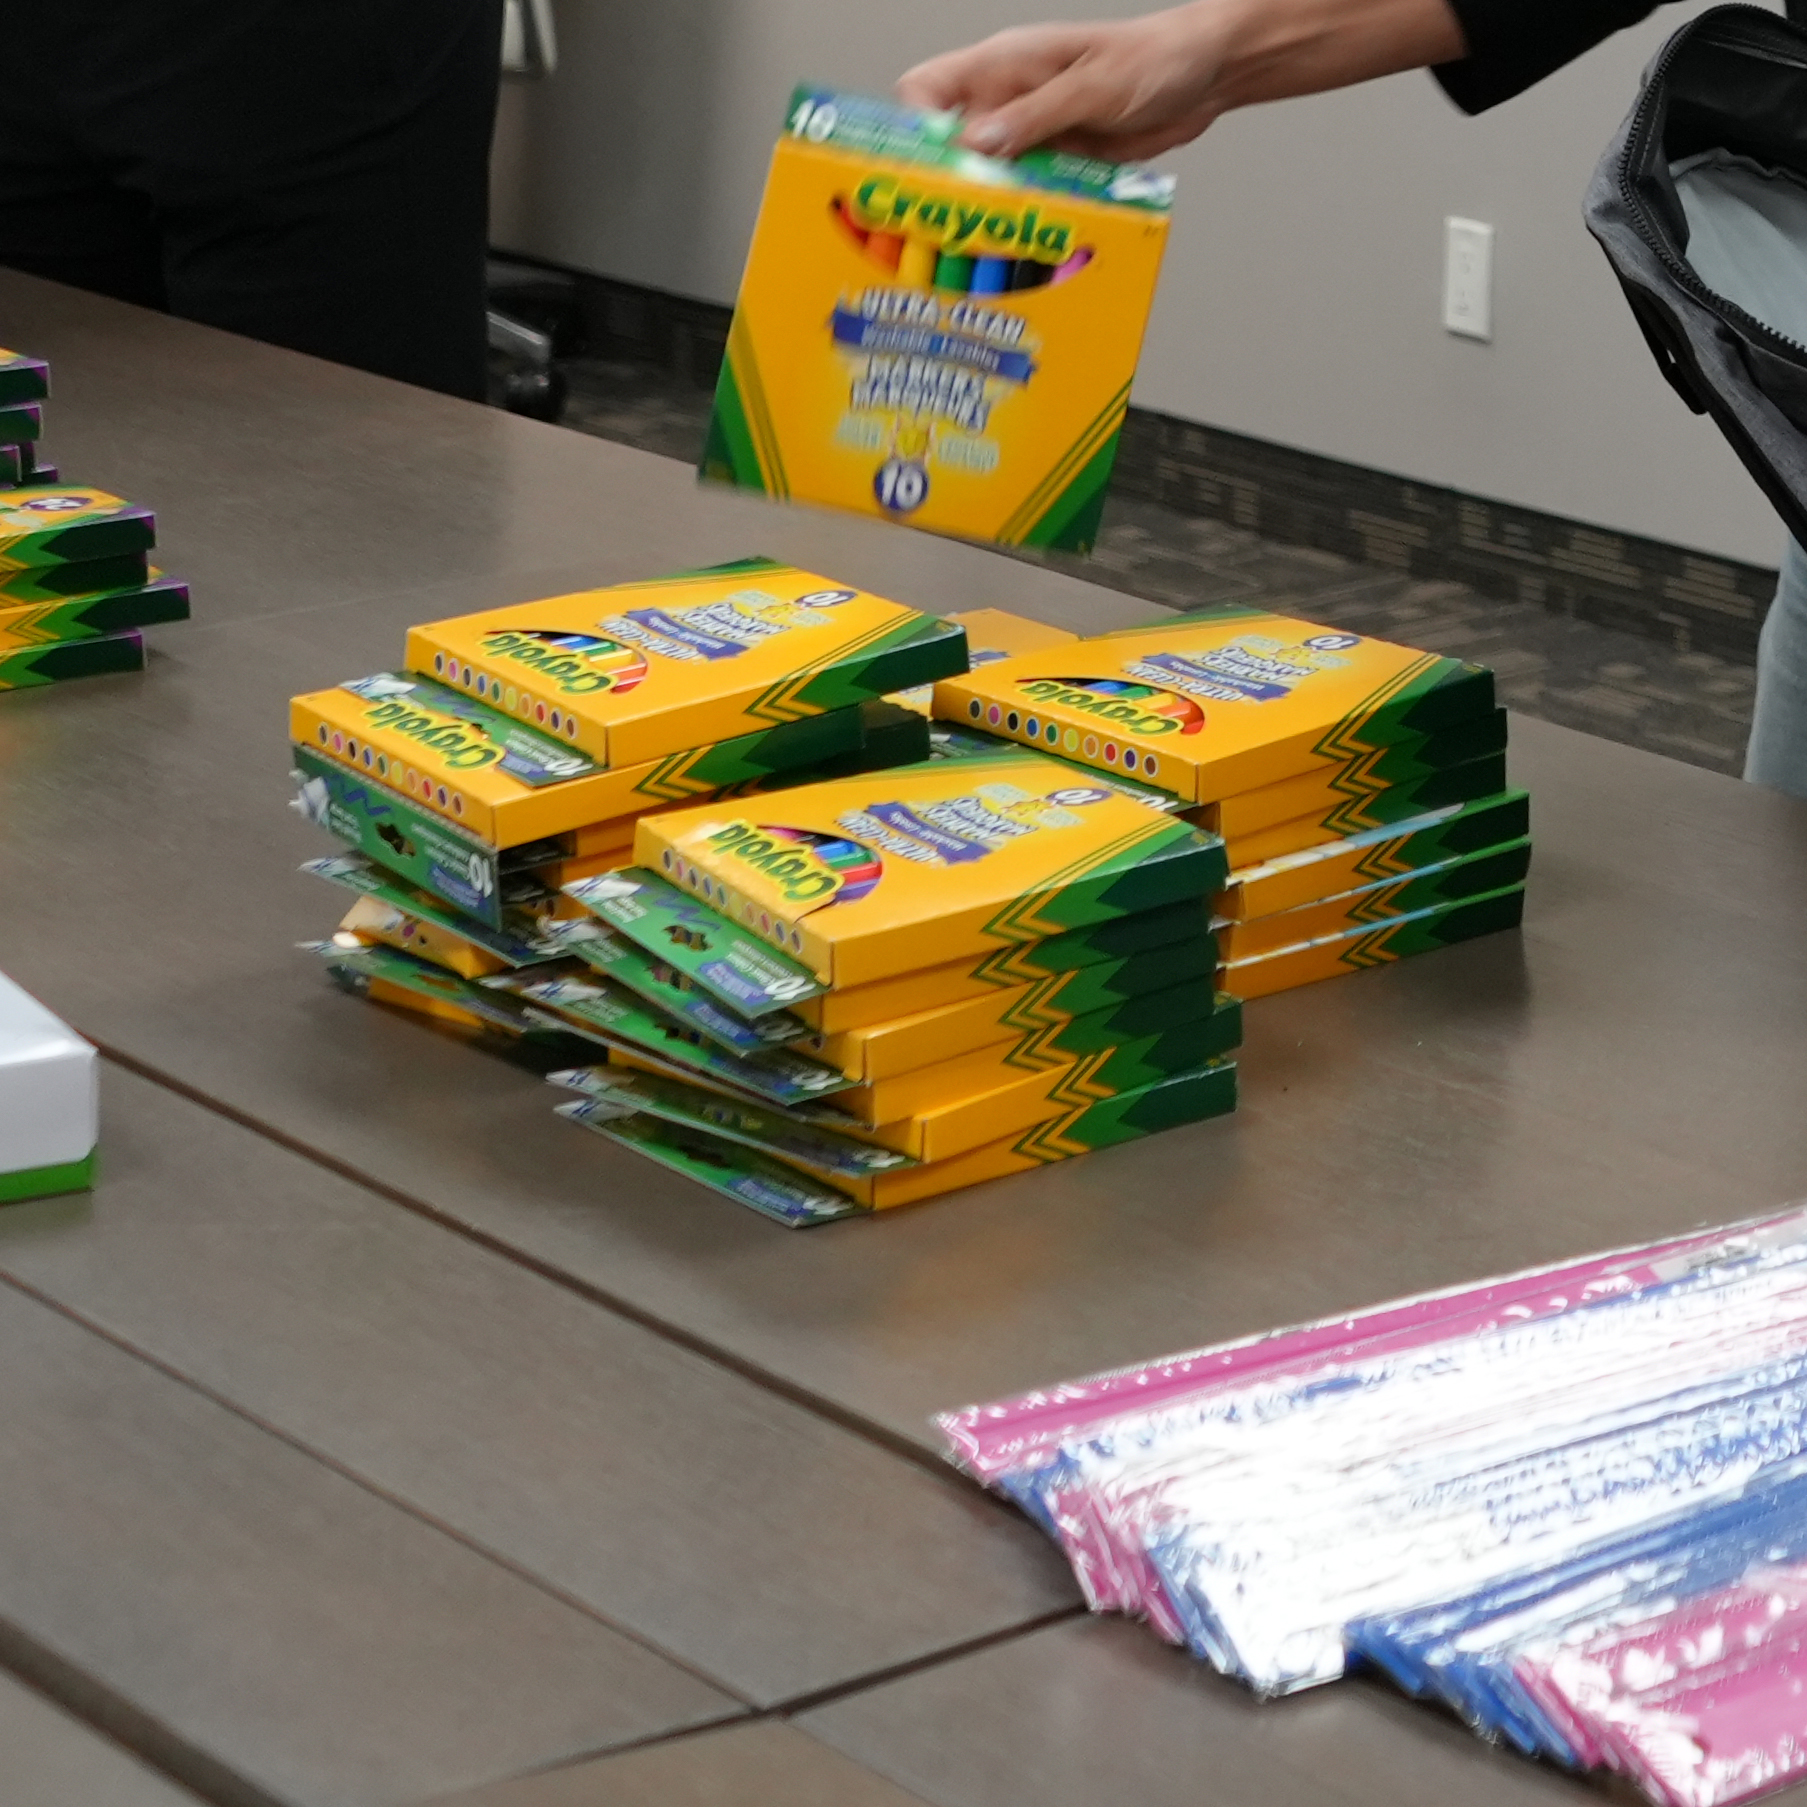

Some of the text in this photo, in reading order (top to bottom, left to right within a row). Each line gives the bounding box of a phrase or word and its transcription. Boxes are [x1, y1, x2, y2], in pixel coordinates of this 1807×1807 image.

[790, 98, 839, 143] 10
[854, 176, 1073, 258] Crayola
[882, 458, 924, 510] 10
[803, 591, 849, 607] 10
[481, 632, 615, 694] Crayola
[1310, 635, 1355, 650] 10
[1019, 680, 1182, 736] Crayola
[364, 701, 501, 769] Crayola
[544, 756, 594, 777] 10
[1056, 788, 1104, 806] 10
[468, 852, 494, 898] 10
[708, 820, 841, 901] Crayola
[765, 975, 816, 1001] 10
